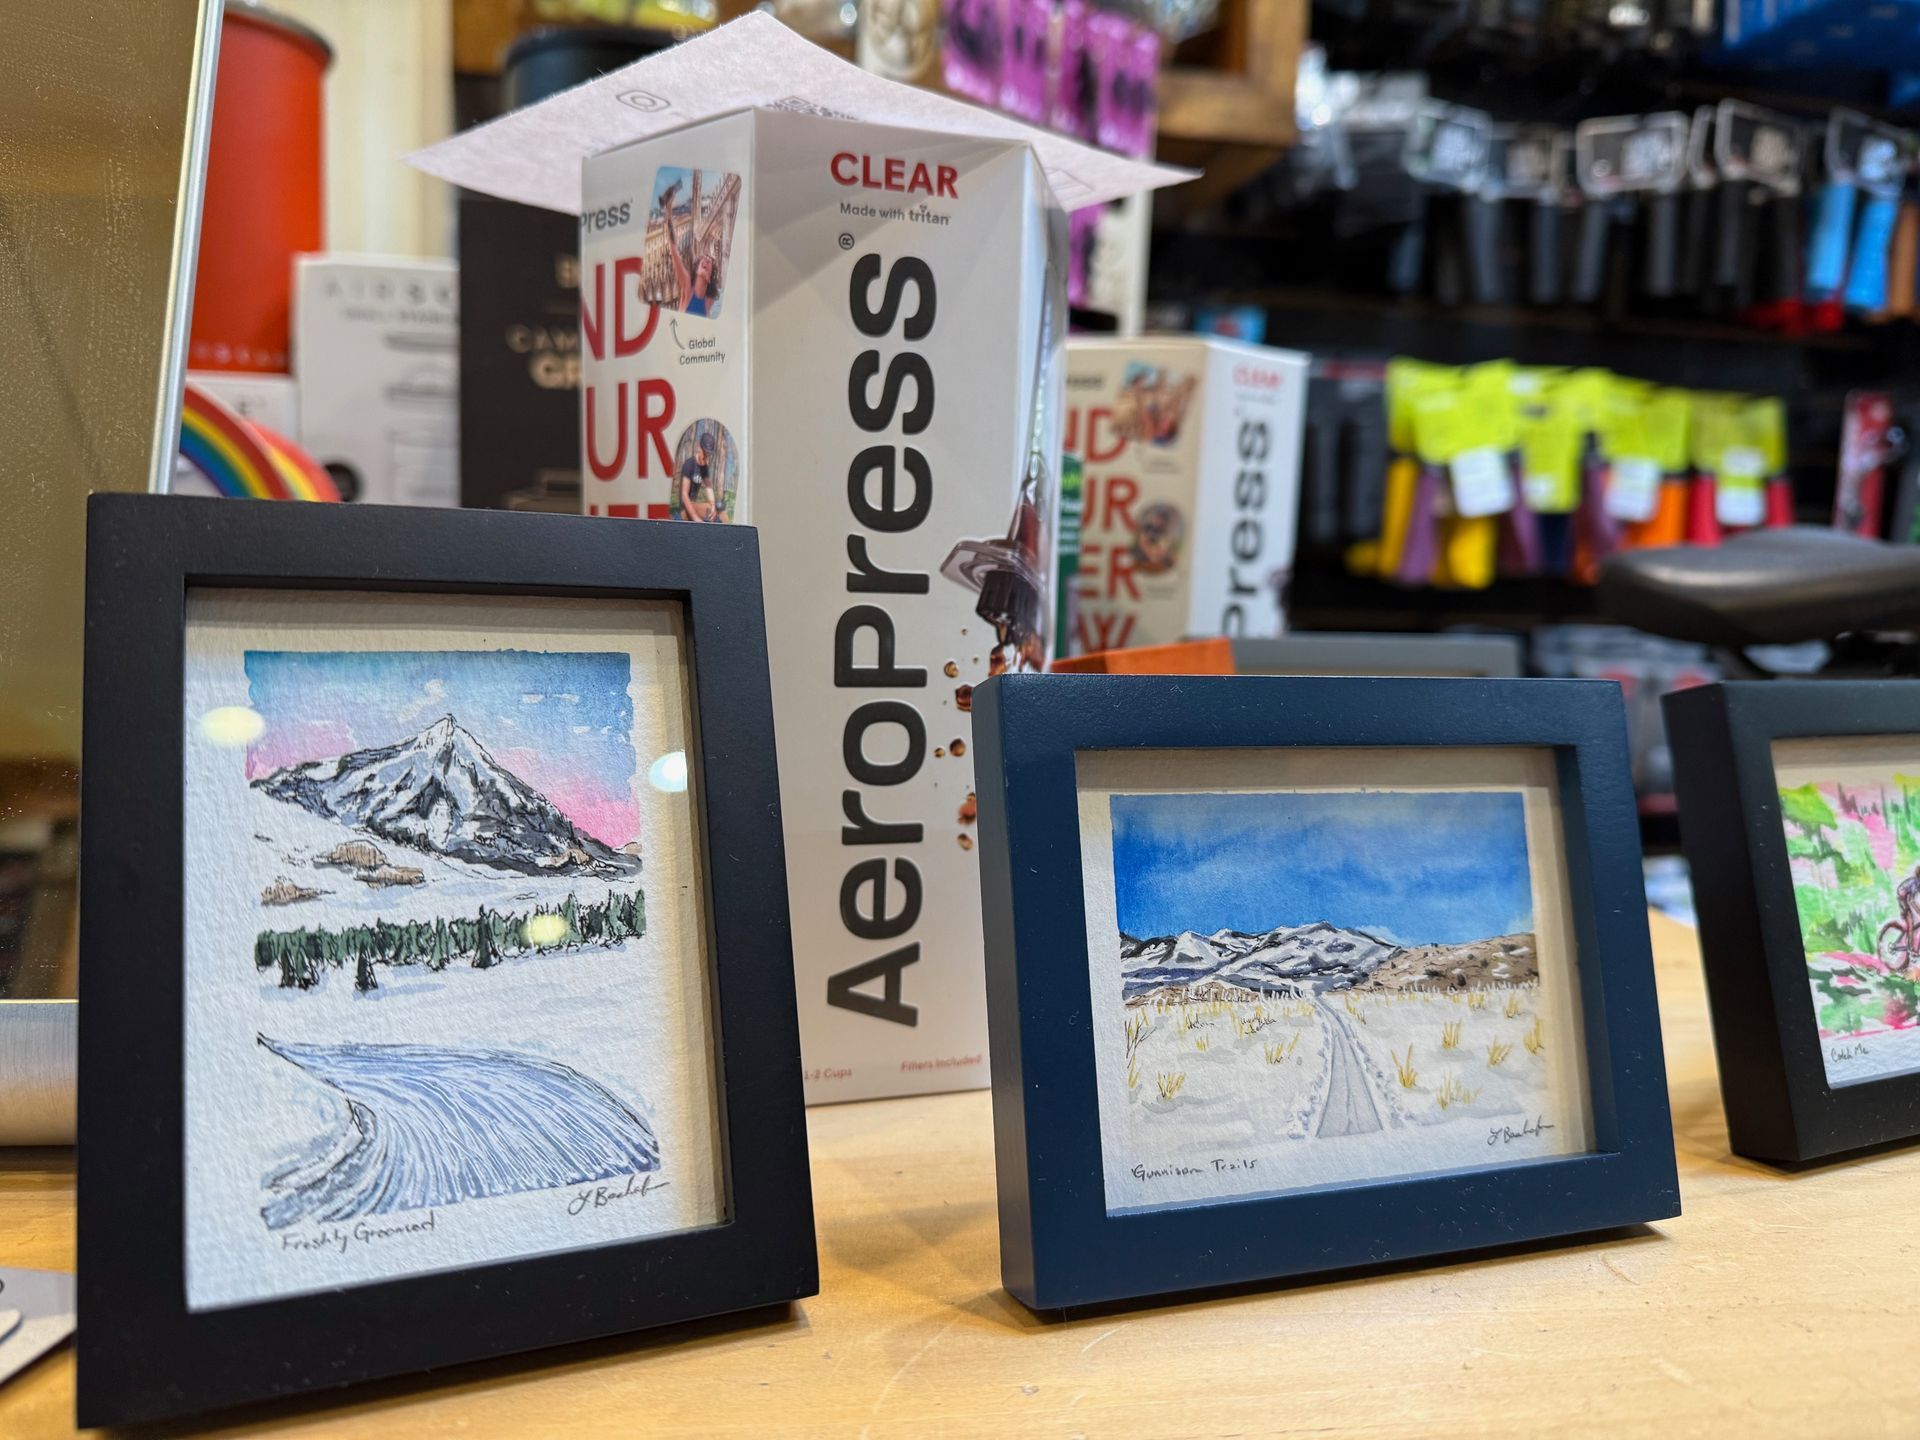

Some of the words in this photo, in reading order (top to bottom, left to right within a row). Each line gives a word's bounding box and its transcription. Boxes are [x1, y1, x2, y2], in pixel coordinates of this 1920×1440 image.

[830, 151, 959, 200] CLEAR
[840, 202, 877, 218] Made
[879, 206, 906, 222] with
[909, 203, 952, 226] tritan
[688, 337, 717, 350] Global
[679, 351, 726, 367] Community
[586, 378, 677, 482] UR
[824, 1067, 852, 1081] Cups
[900, 1058, 933, 1073] Filters
[1130, 1163, 1204, 1182] Gunnison
[1210, 1158, 1257, 1172] Trails
[281, 1229, 348, 1255] Freshly
